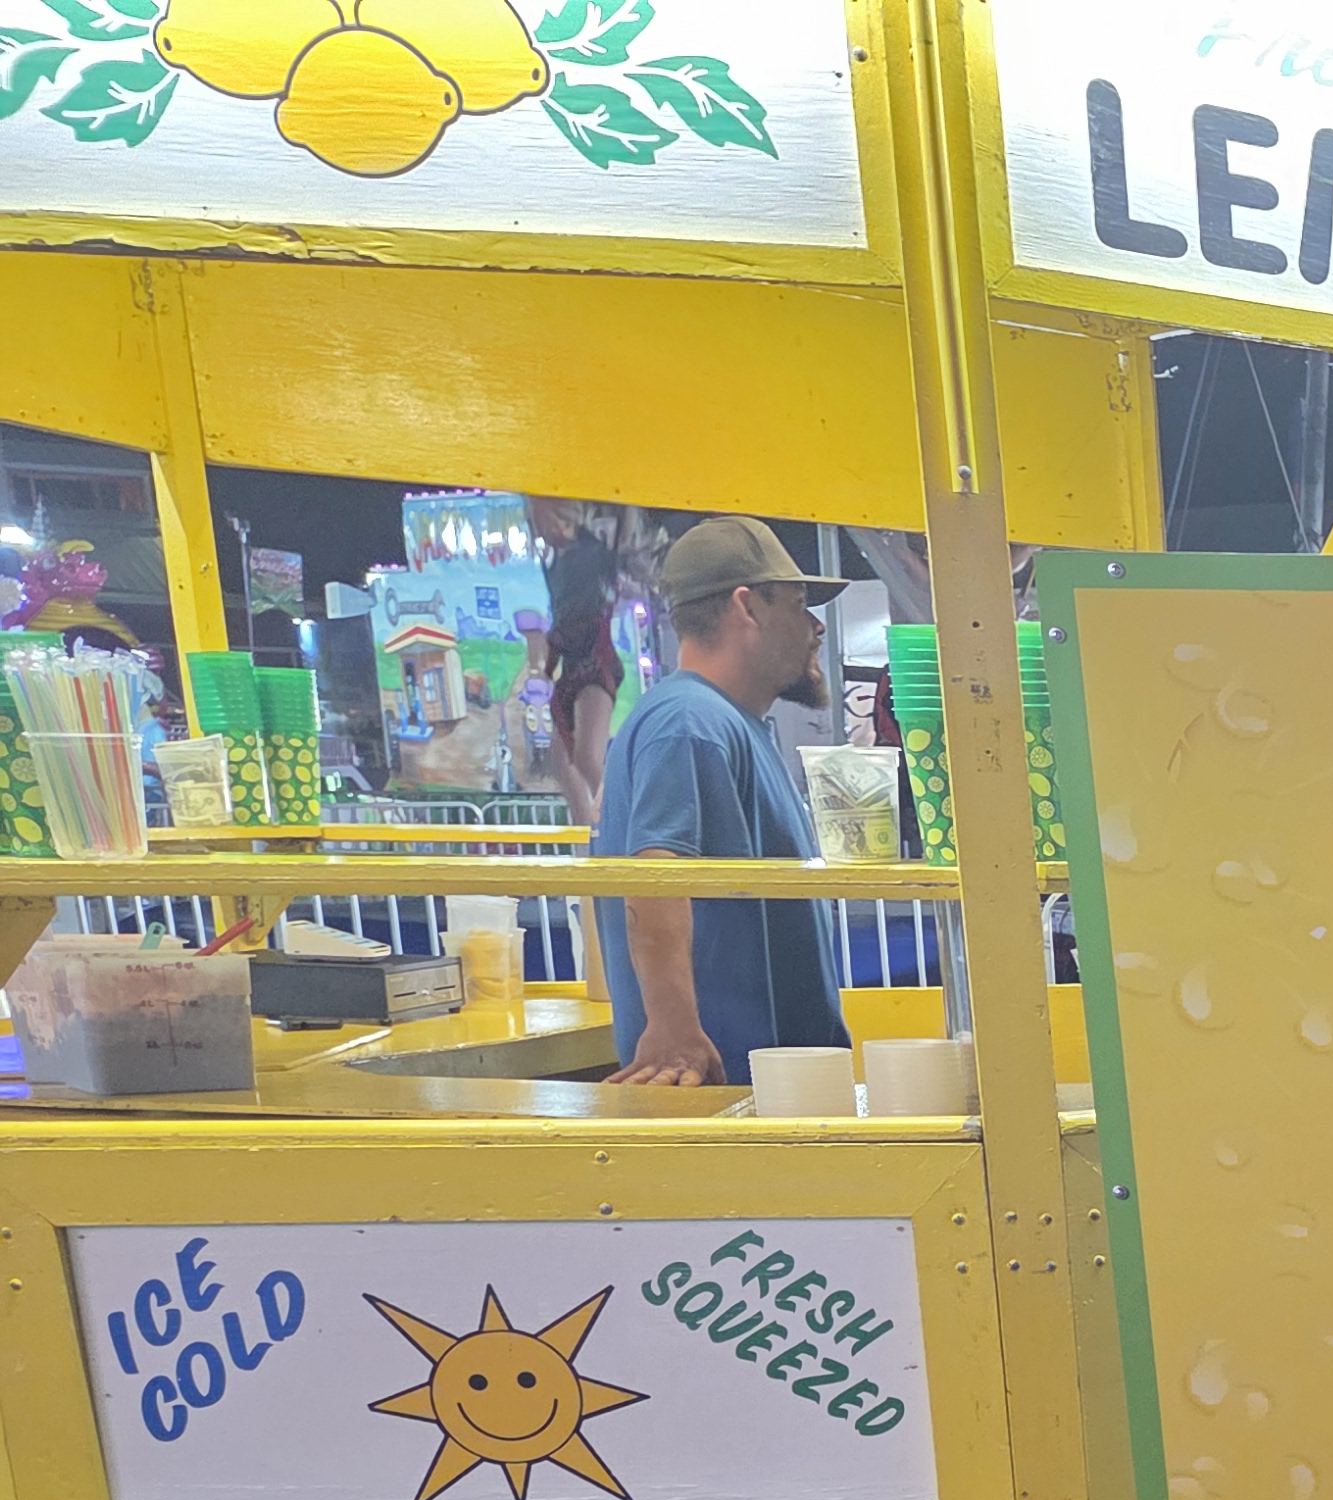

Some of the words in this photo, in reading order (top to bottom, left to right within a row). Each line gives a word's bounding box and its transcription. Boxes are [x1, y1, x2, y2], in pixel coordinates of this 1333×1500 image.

[107, 1237, 224, 1375] ICE
[140, 1270, 306, 1442] COLD
[641, 1261, 905, 1437] SQUEEZED
[710, 1228, 893, 1356] FRESH
